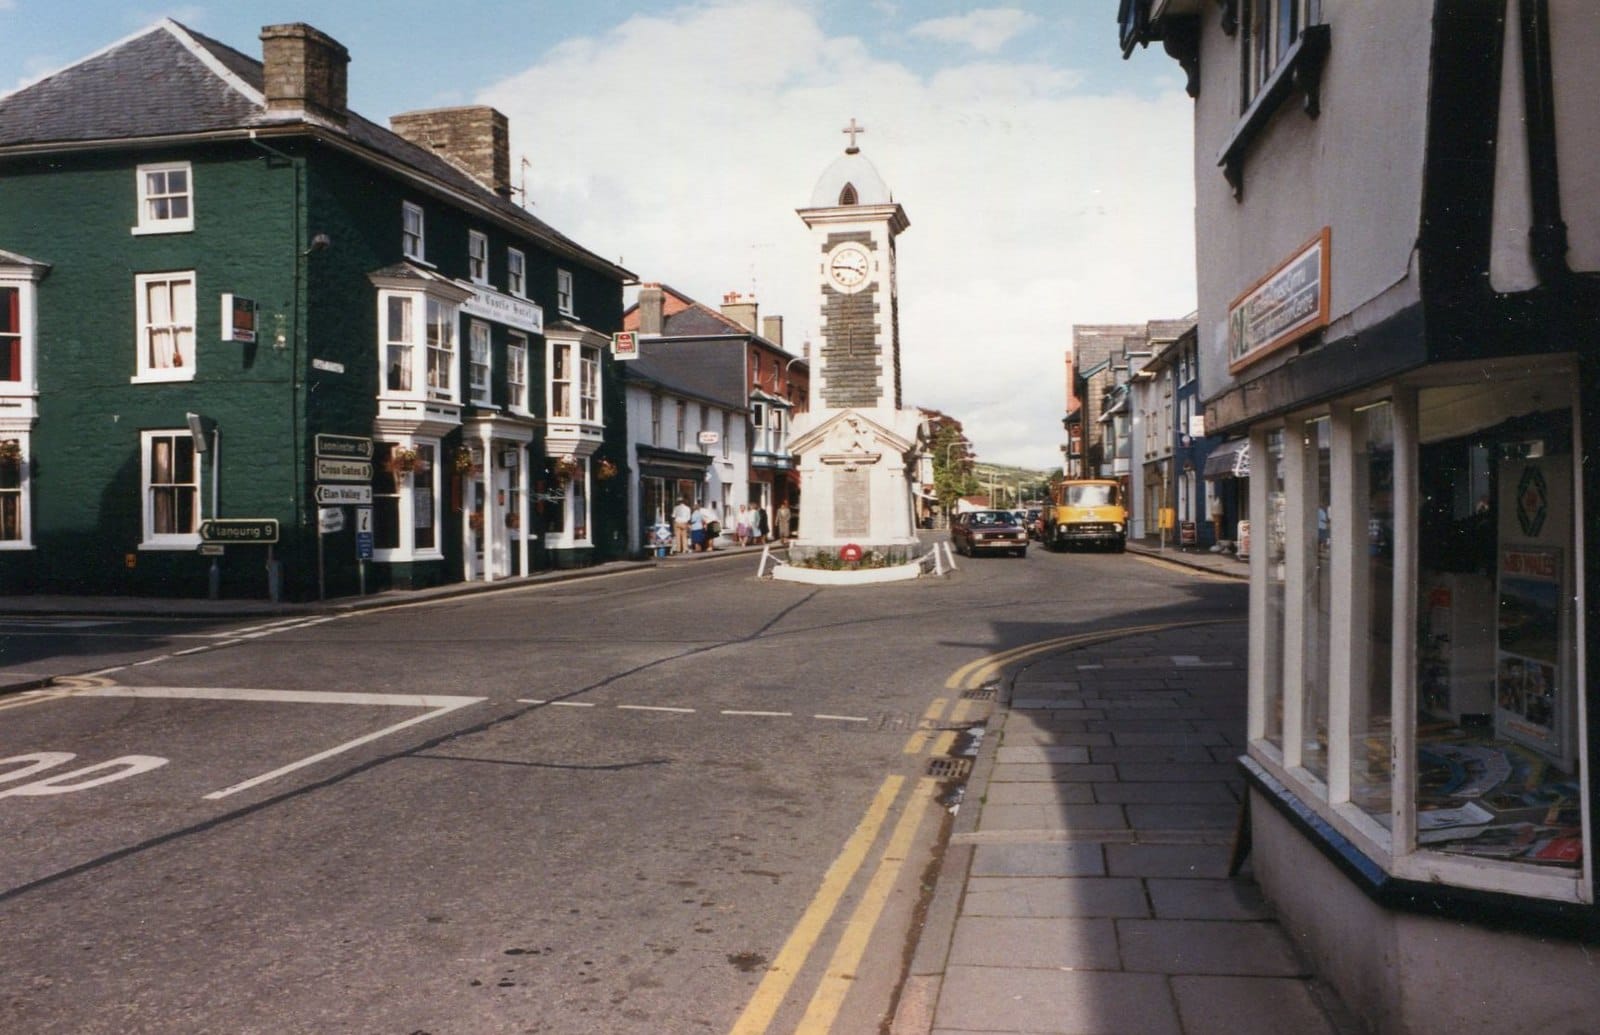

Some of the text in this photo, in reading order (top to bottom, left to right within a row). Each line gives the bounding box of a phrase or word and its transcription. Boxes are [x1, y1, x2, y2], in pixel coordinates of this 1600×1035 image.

[320, 464, 340, 475] Cross
[342, 465, 361, 476] Gates
[324, 488, 339, 499] Elan
[340, 488, 361, 501] Valley
[264, 525, 273, 536] 9
